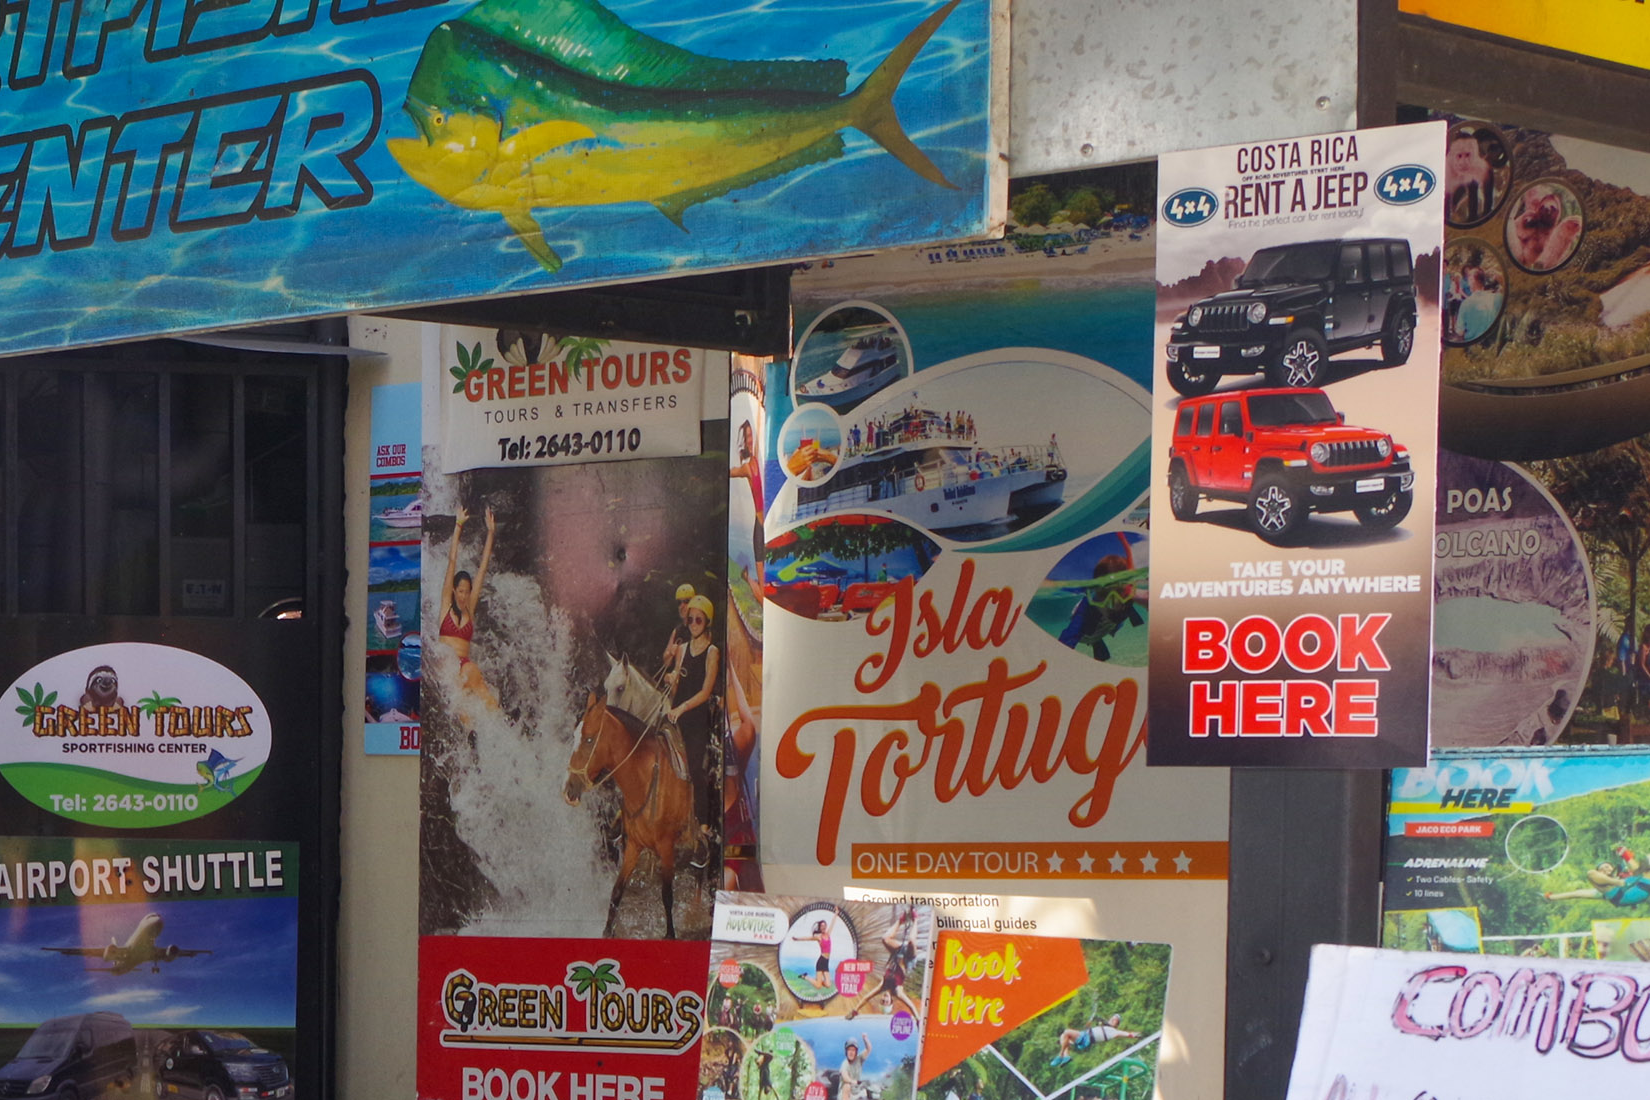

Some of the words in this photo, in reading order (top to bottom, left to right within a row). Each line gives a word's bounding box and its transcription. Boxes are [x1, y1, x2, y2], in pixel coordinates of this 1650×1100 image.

[1237, 142, 1301, 174] COSTA
[1310, 135, 1358, 166] RICA
[1224, 180, 1285, 219] RENT
[1290, 178, 1306, 212] A
[1312, 172, 1368, 211] JEEP
[464, 362, 569, 402] GREEN
[583, 348, 693, 391] TOURS
[484, 408, 540, 424] TOURS
[574, 395, 678, 417] TRANSFERS
[535, 427, 642, 459] 2643-0110
[376, 455, 406, 468] COMBOS
[1446, 488, 1512, 513] POAS
[1434, 528, 1541, 557] OLCANO
[1230, 561, 1283, 578] TAKE
[1288, 559, 1345, 576] YOUR
[1160, 580, 1293, 599] ADVENTURES
[1299, 576, 1421, 594] ANYWHERE
[854, 557, 1024, 694] Isla
[1182, 613, 1392, 674] BOOK
[32, 705, 140, 738] GREEN
[152, 705, 254, 738] TOURS
[1189, 679, 1379, 737] HERE
[62, 743, 155, 754] SPORTFISHING
[158, 743, 207, 754] CENTER
[776, 657, 1148, 867] Tortug
[50, 794, 87, 812] Tel:
[92, 794, 198, 812] 2643-0110
[1416, 826, 1438, 834] JACO
[1457, 825, 1482, 834] PARK
[142, 850, 283, 894] SHUTTLE
[857, 852, 912, 874] ONE
[916, 851, 967, 874] DAY
[970, 851, 1039, 874] TOUR
[1404, 858, 1489, 869] ADRENALINE
[1466, 875, 1494, 885] Safety
[911, 894, 999, 909] transportation
[937, 916, 990, 931] bilingual
[994, 918, 1037, 932] guides
[944, 938, 1021, 983] Book
[938, 984, 1004, 1026] Here
